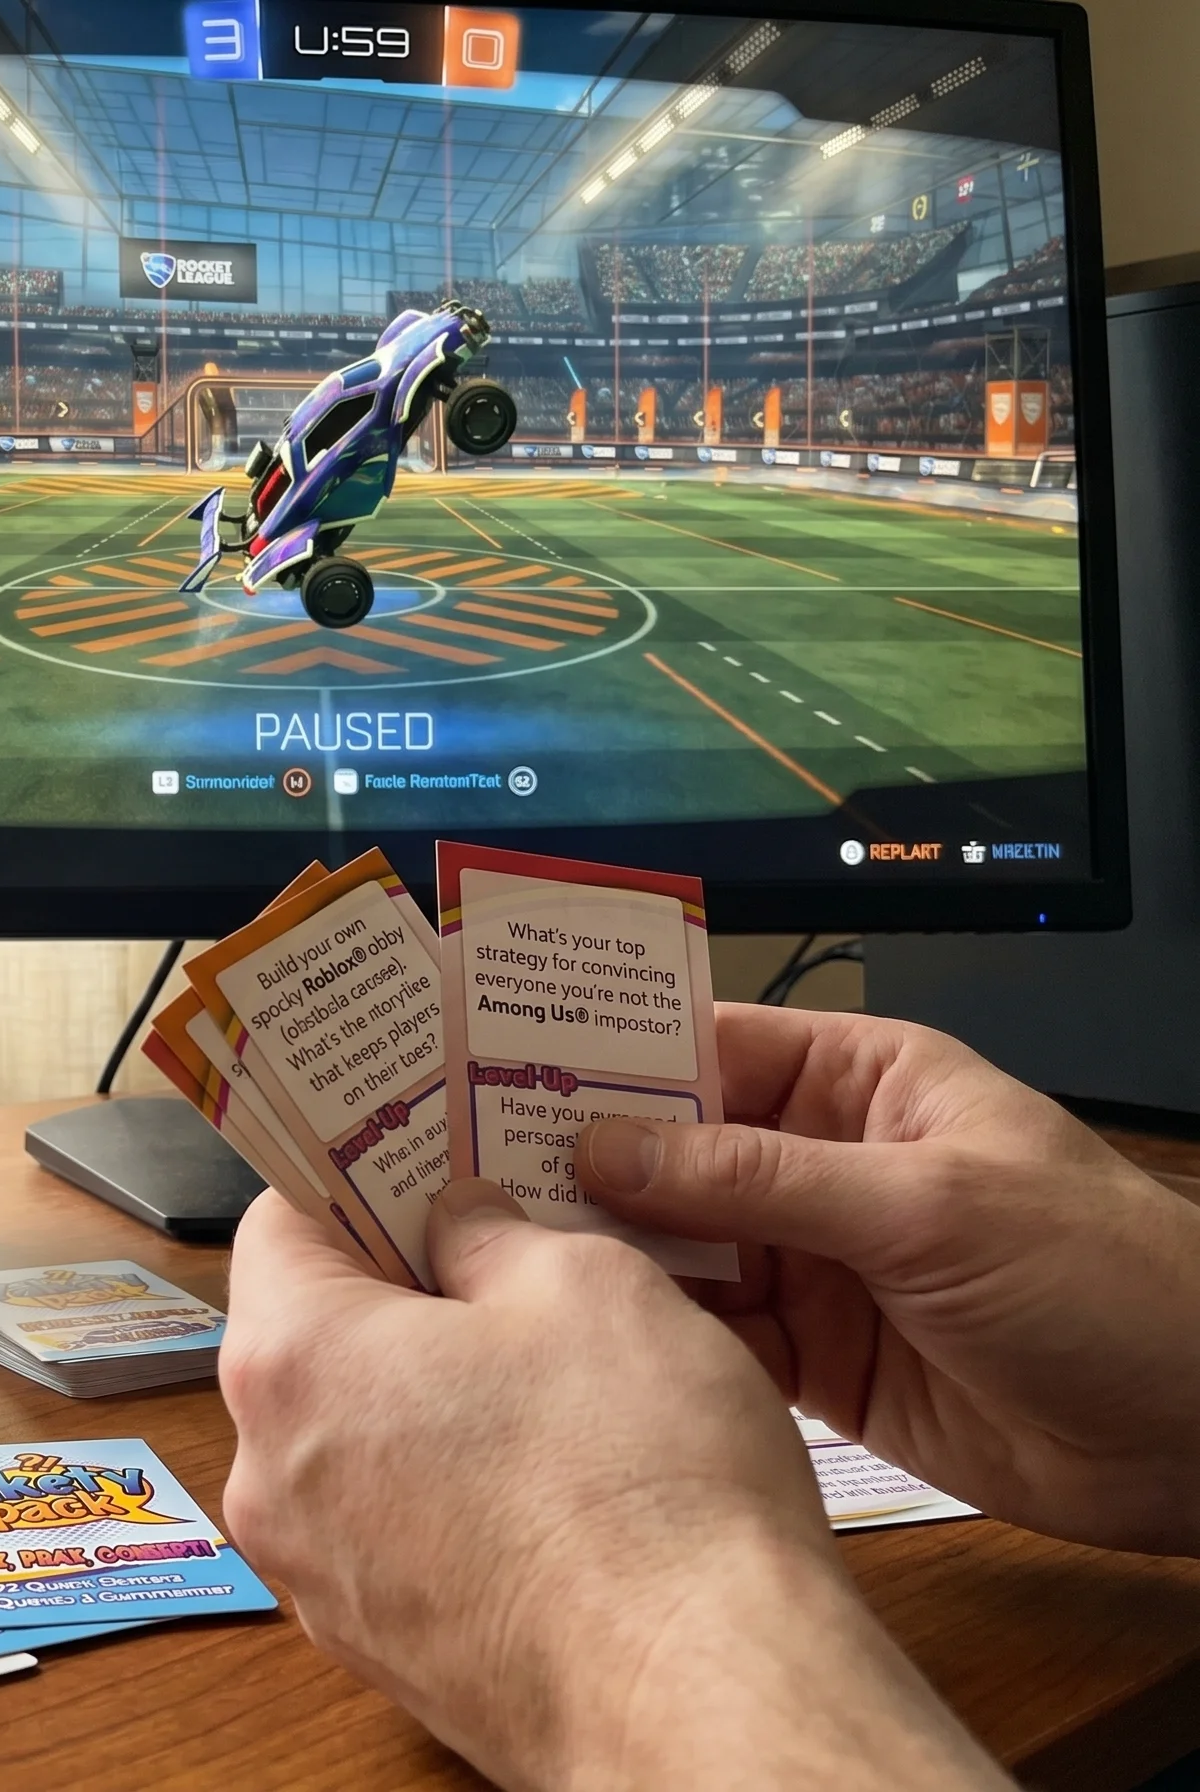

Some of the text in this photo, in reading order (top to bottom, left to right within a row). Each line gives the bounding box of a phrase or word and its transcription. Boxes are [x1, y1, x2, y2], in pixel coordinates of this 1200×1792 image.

[177, 271, 234, 285] LEAGUE
[255, 713, 433, 751] PAUSED
[257, 919, 367, 990] Build your own
[368, 926, 405, 957] obby
[507, 921, 645, 959] What's your top
[476, 945, 675, 989] strategy for convincing
[475, 972, 682, 1011] everyone you're not the
[477, 994, 546, 1024] Among
[594, 1010, 681, 1036] impostor?
[285, 1033, 341, 1071] What's
[339, 1016, 368, 1039] the
[309, 1003, 441, 1092] that keeps players
[343, 1032, 438, 1106] on their toes?
[501, 1097, 547, 1118] Have
[552, 1106, 584, 1124] you
[408, 1136, 424, 1153] in
[390, 1170, 417, 1198] and
[541, 1156, 559, 1174] of
[501, 1178, 542, 1199] How
[548, 1184, 577, 1203] did
